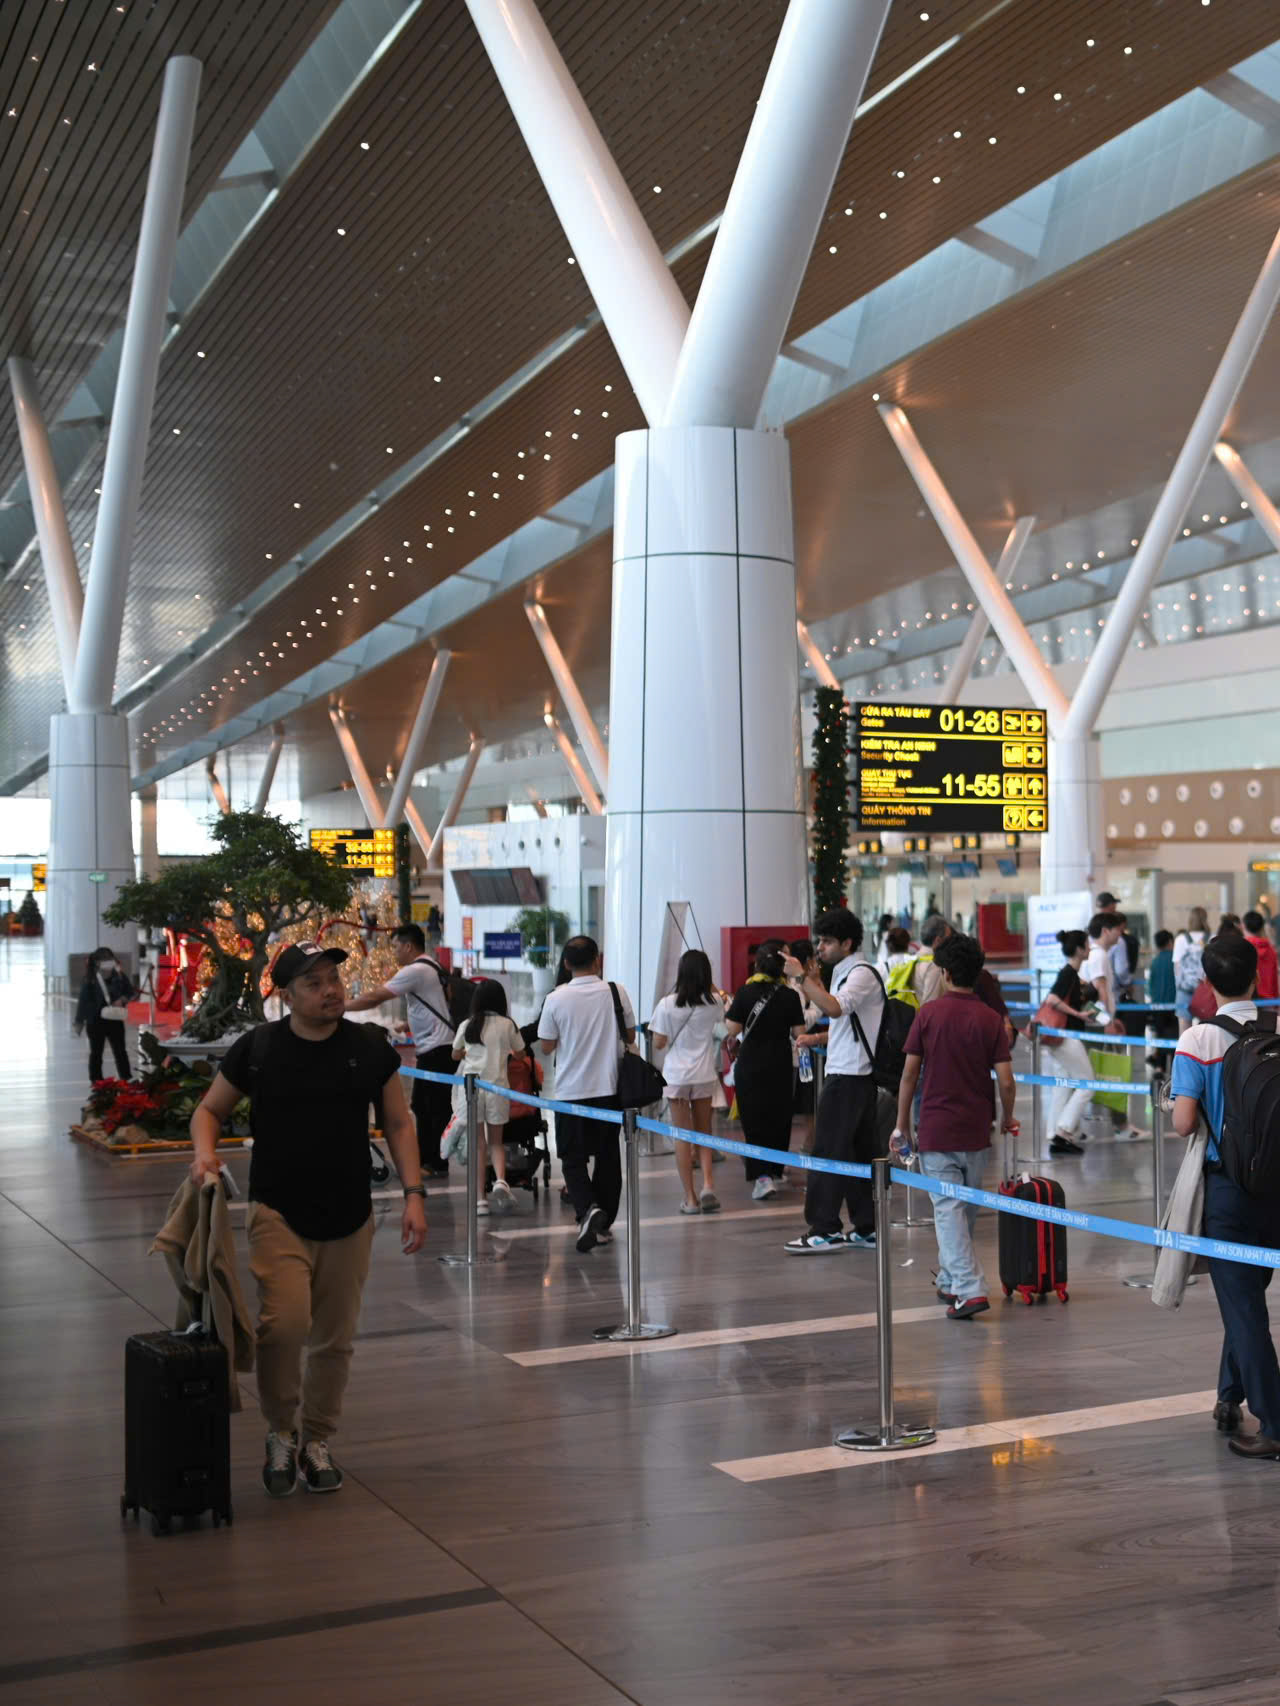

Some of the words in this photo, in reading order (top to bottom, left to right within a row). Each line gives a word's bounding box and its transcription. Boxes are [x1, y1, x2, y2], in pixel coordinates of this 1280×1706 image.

[939, 709, 999, 733] 01-26
[942, 774, 1000, 797] 11-55
[917, 806, 932, 816] TIN
[861, 817, 906, 826] Information
[940, 1182, 955, 1197] TIA
[1153, 1230, 1173, 1248] TIA
